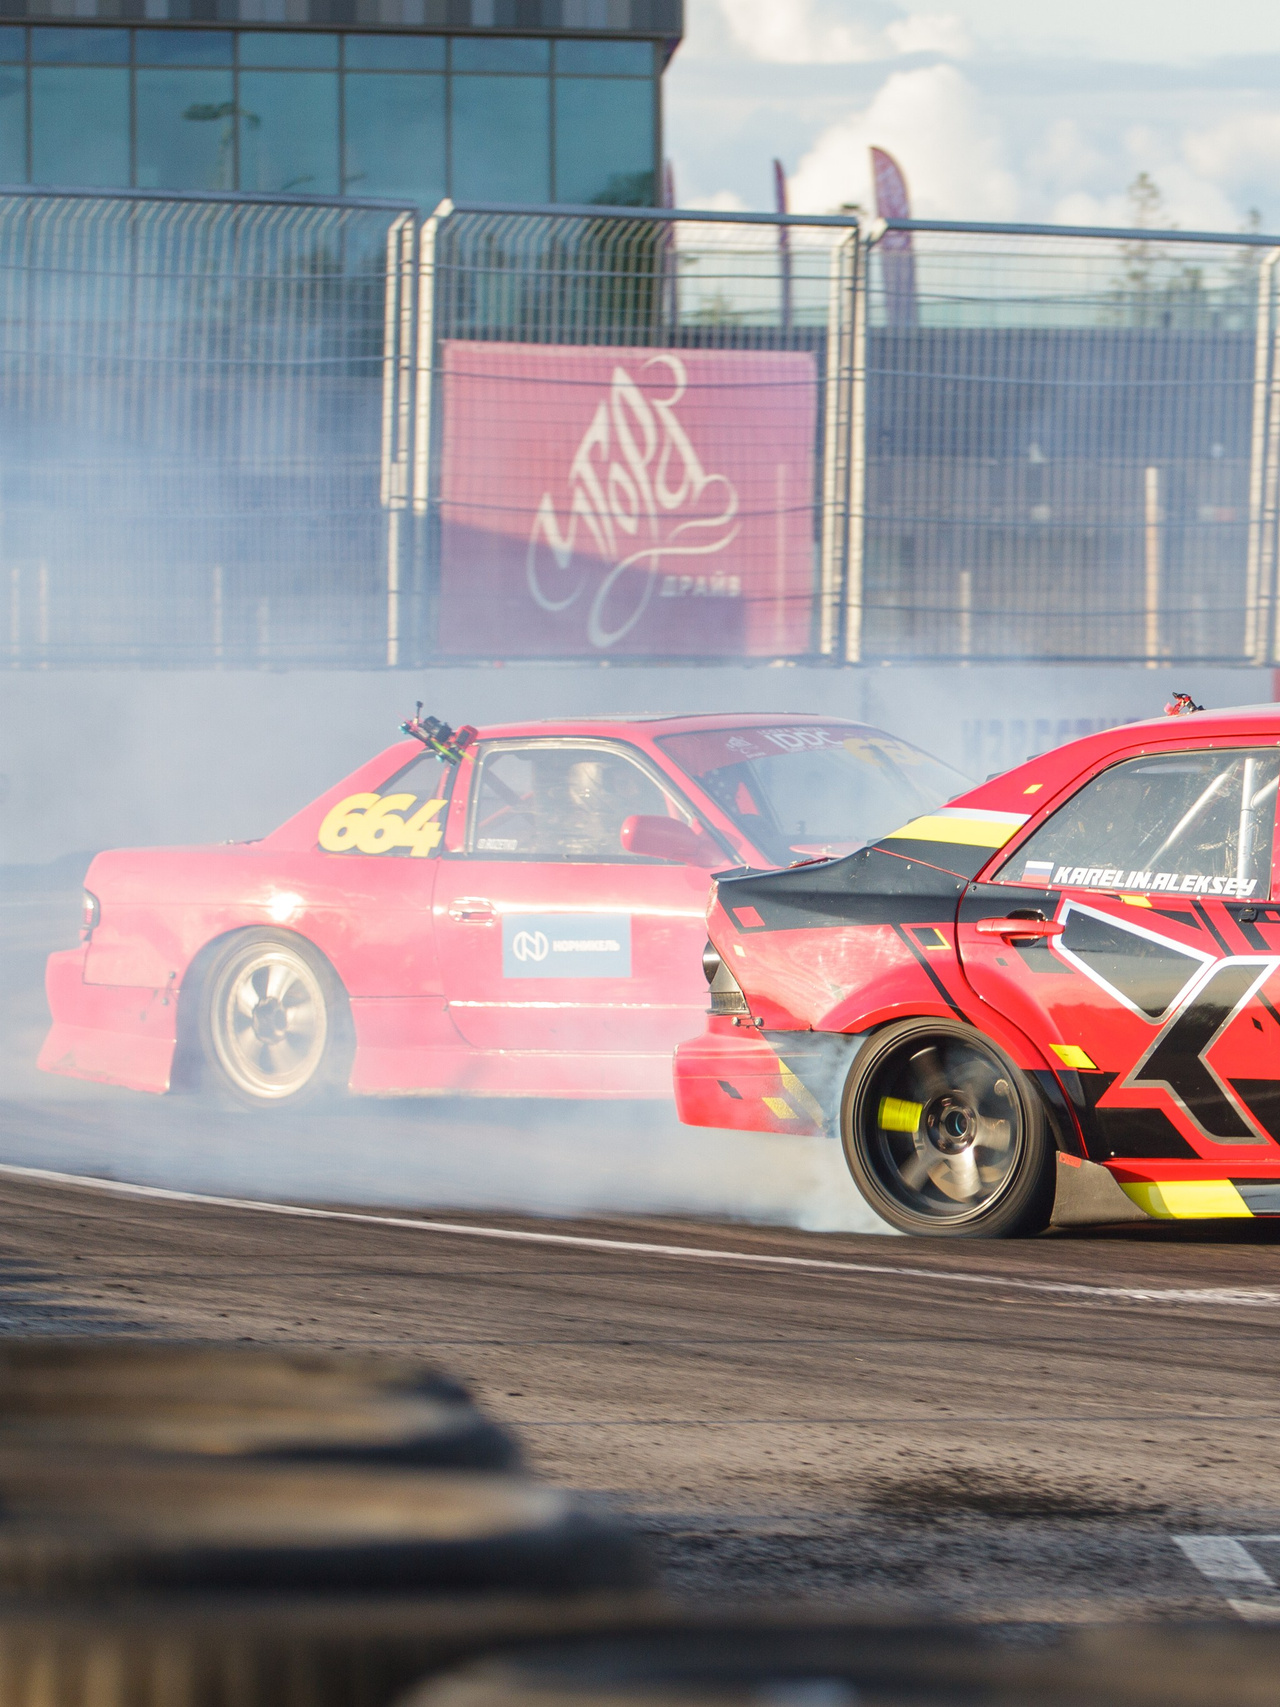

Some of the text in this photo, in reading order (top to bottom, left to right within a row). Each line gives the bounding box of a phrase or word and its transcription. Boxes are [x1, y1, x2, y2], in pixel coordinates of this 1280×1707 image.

[660, 570, 742, 597] ДРАЙВ
[318, 792, 448, 857] 664
[1053, 866, 1258, 897] KARELIN.ALEKSEY
